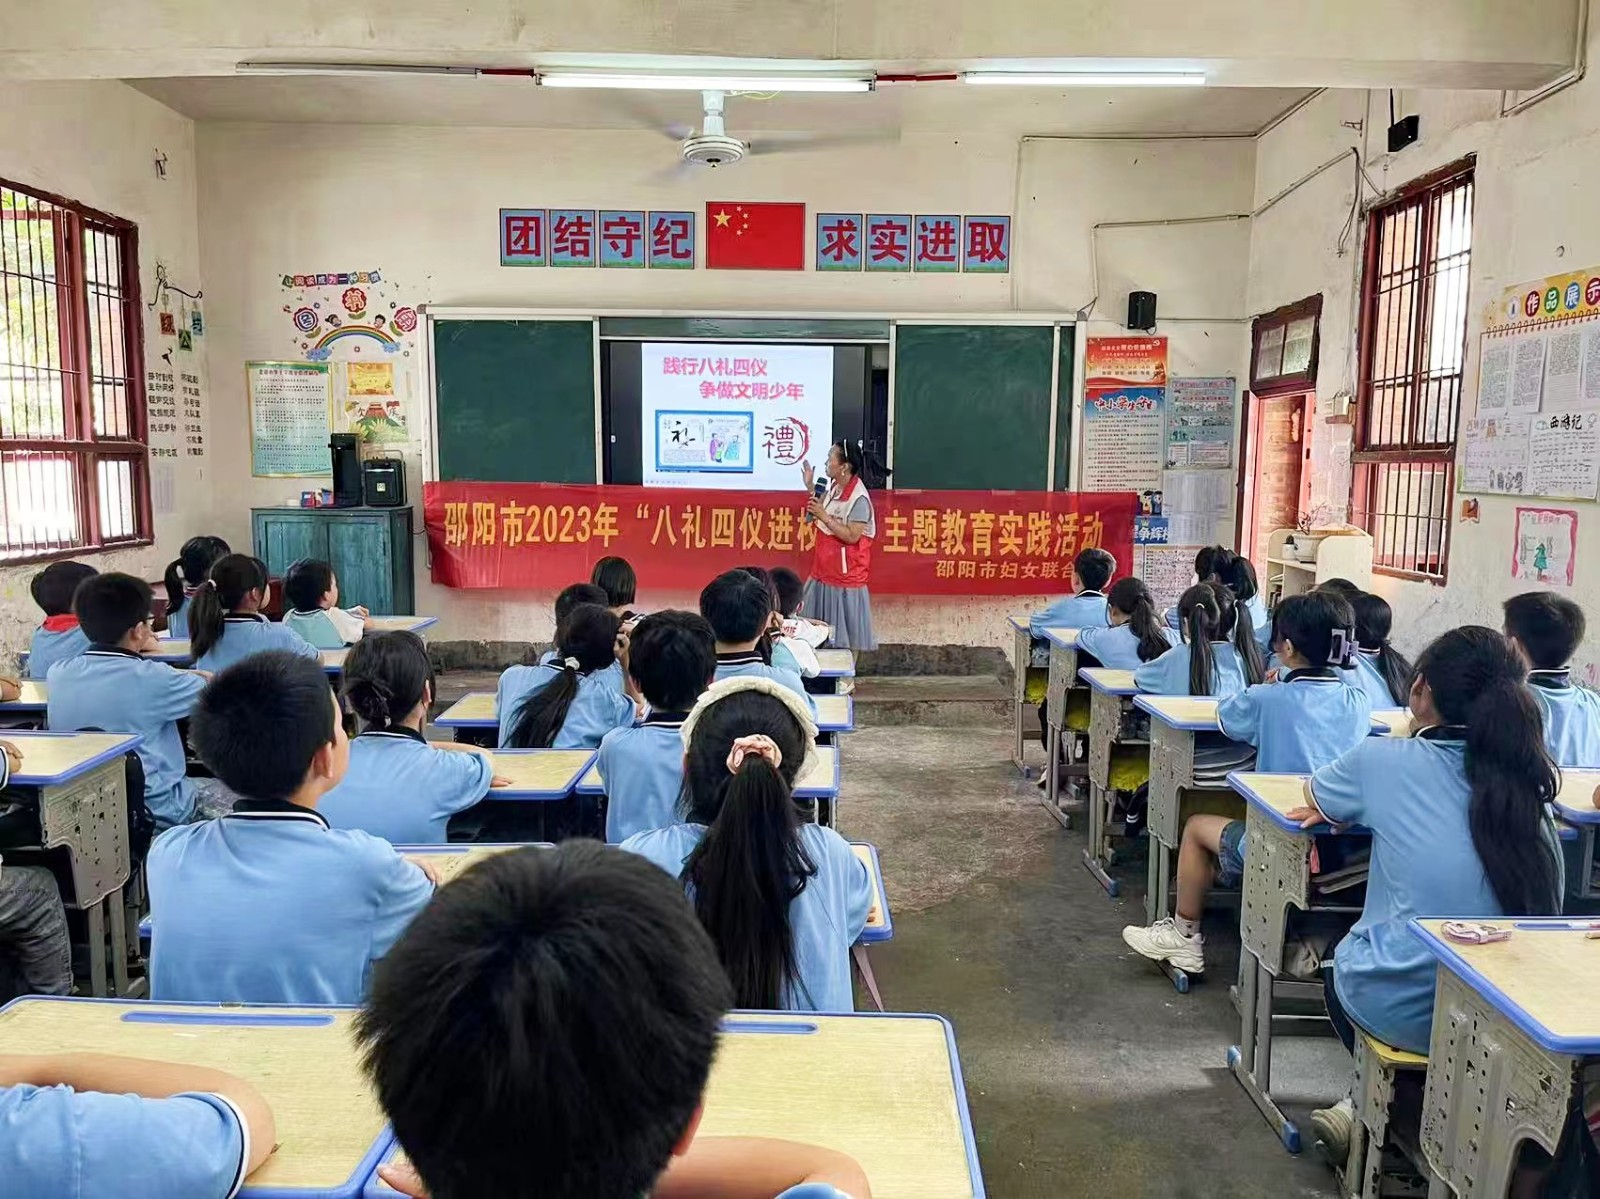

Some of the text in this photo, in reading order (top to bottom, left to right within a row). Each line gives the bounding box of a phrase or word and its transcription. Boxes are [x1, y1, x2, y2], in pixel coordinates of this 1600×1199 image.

[505, 214, 691, 260] 团结守纪
[822, 219, 1007, 263] 求实进取
[1526, 279, 1600, 315] 作品展示
[663, 356, 768, 377] 践行八礼四仪
[699, 380, 804, 401] 争做文明少年
[762, 425, 796, 459] 禮
[936, 560, 1073, 579] 邵阳市妇女联合
